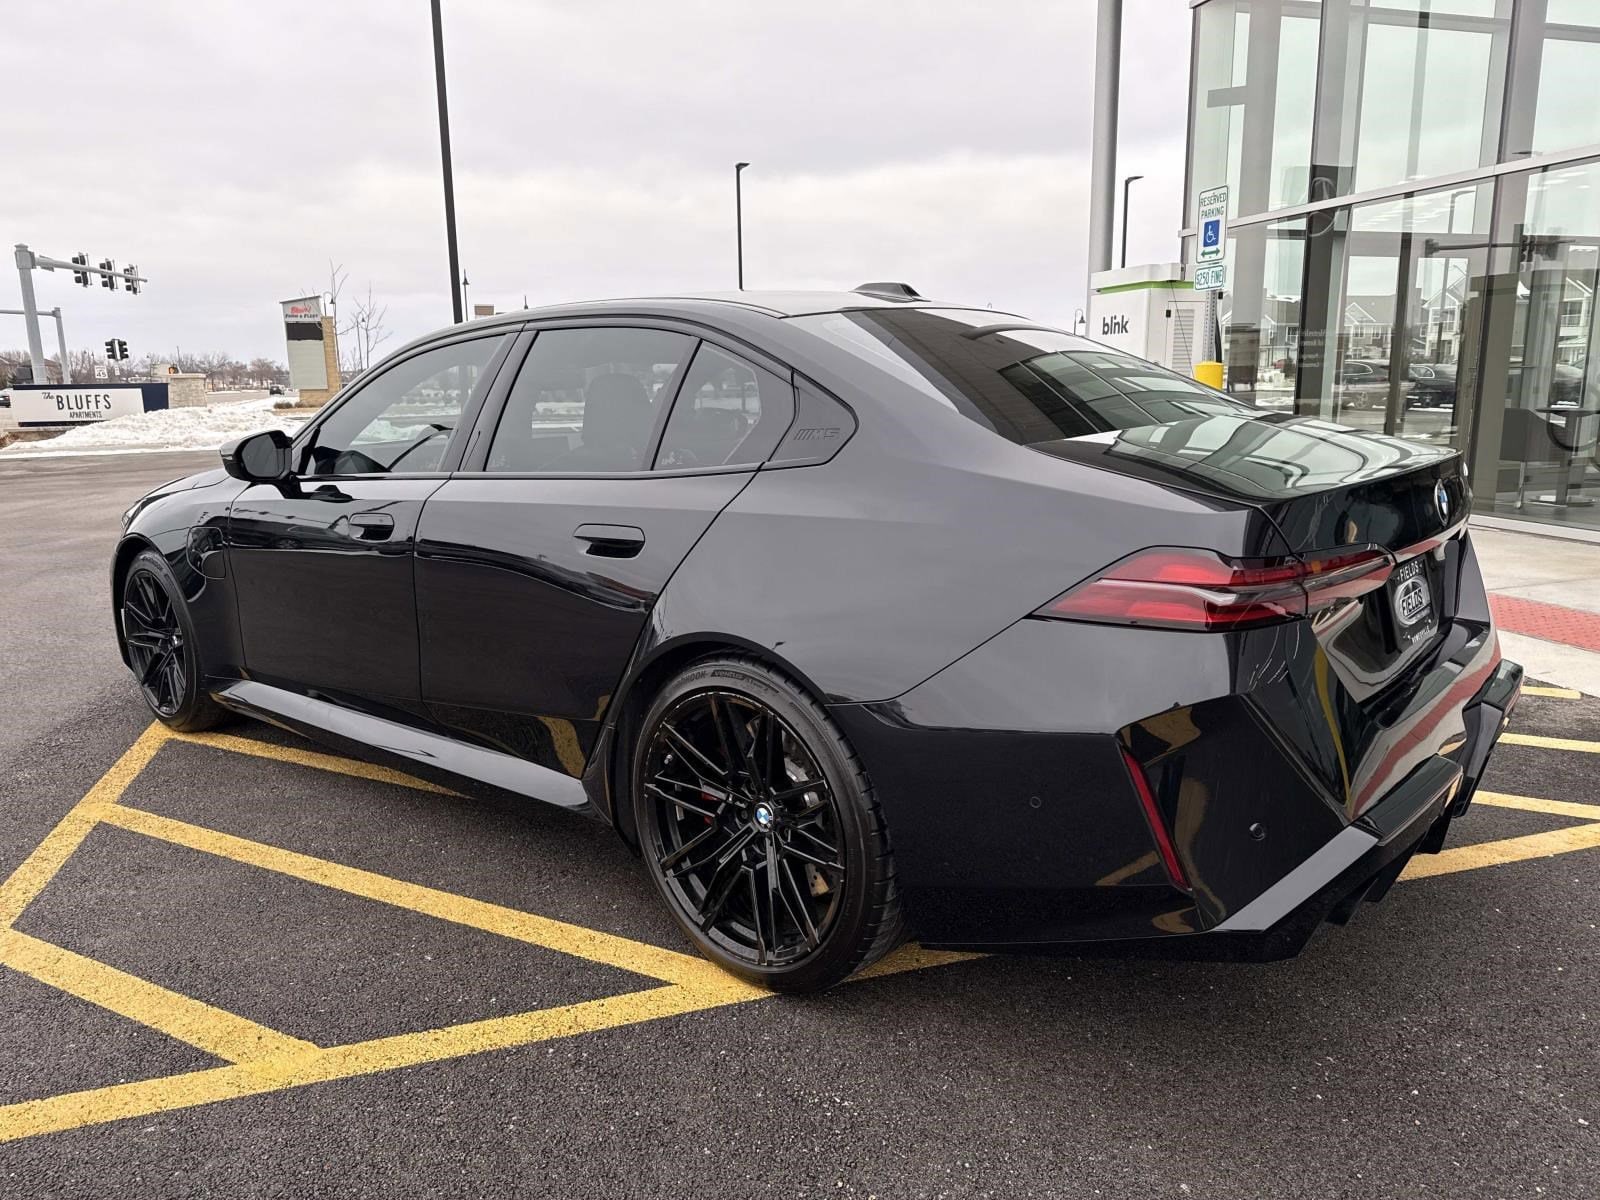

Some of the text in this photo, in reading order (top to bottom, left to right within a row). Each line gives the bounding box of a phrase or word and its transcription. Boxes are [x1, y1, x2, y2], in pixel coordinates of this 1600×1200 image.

[1200, 193, 1226, 207] RESERVED
[1201, 206, 1224, 218] PARKING
[1196, 269, 1223, 286] $250 FINE
[1102, 315, 1129, 335] blink
[56, 394, 112, 410] BLUFFS
[69, 411, 102, 419] APARTMENTS
[1400, 560, 1419, 581] FIELDS
[1401, 588, 1424, 617] FIELDS
